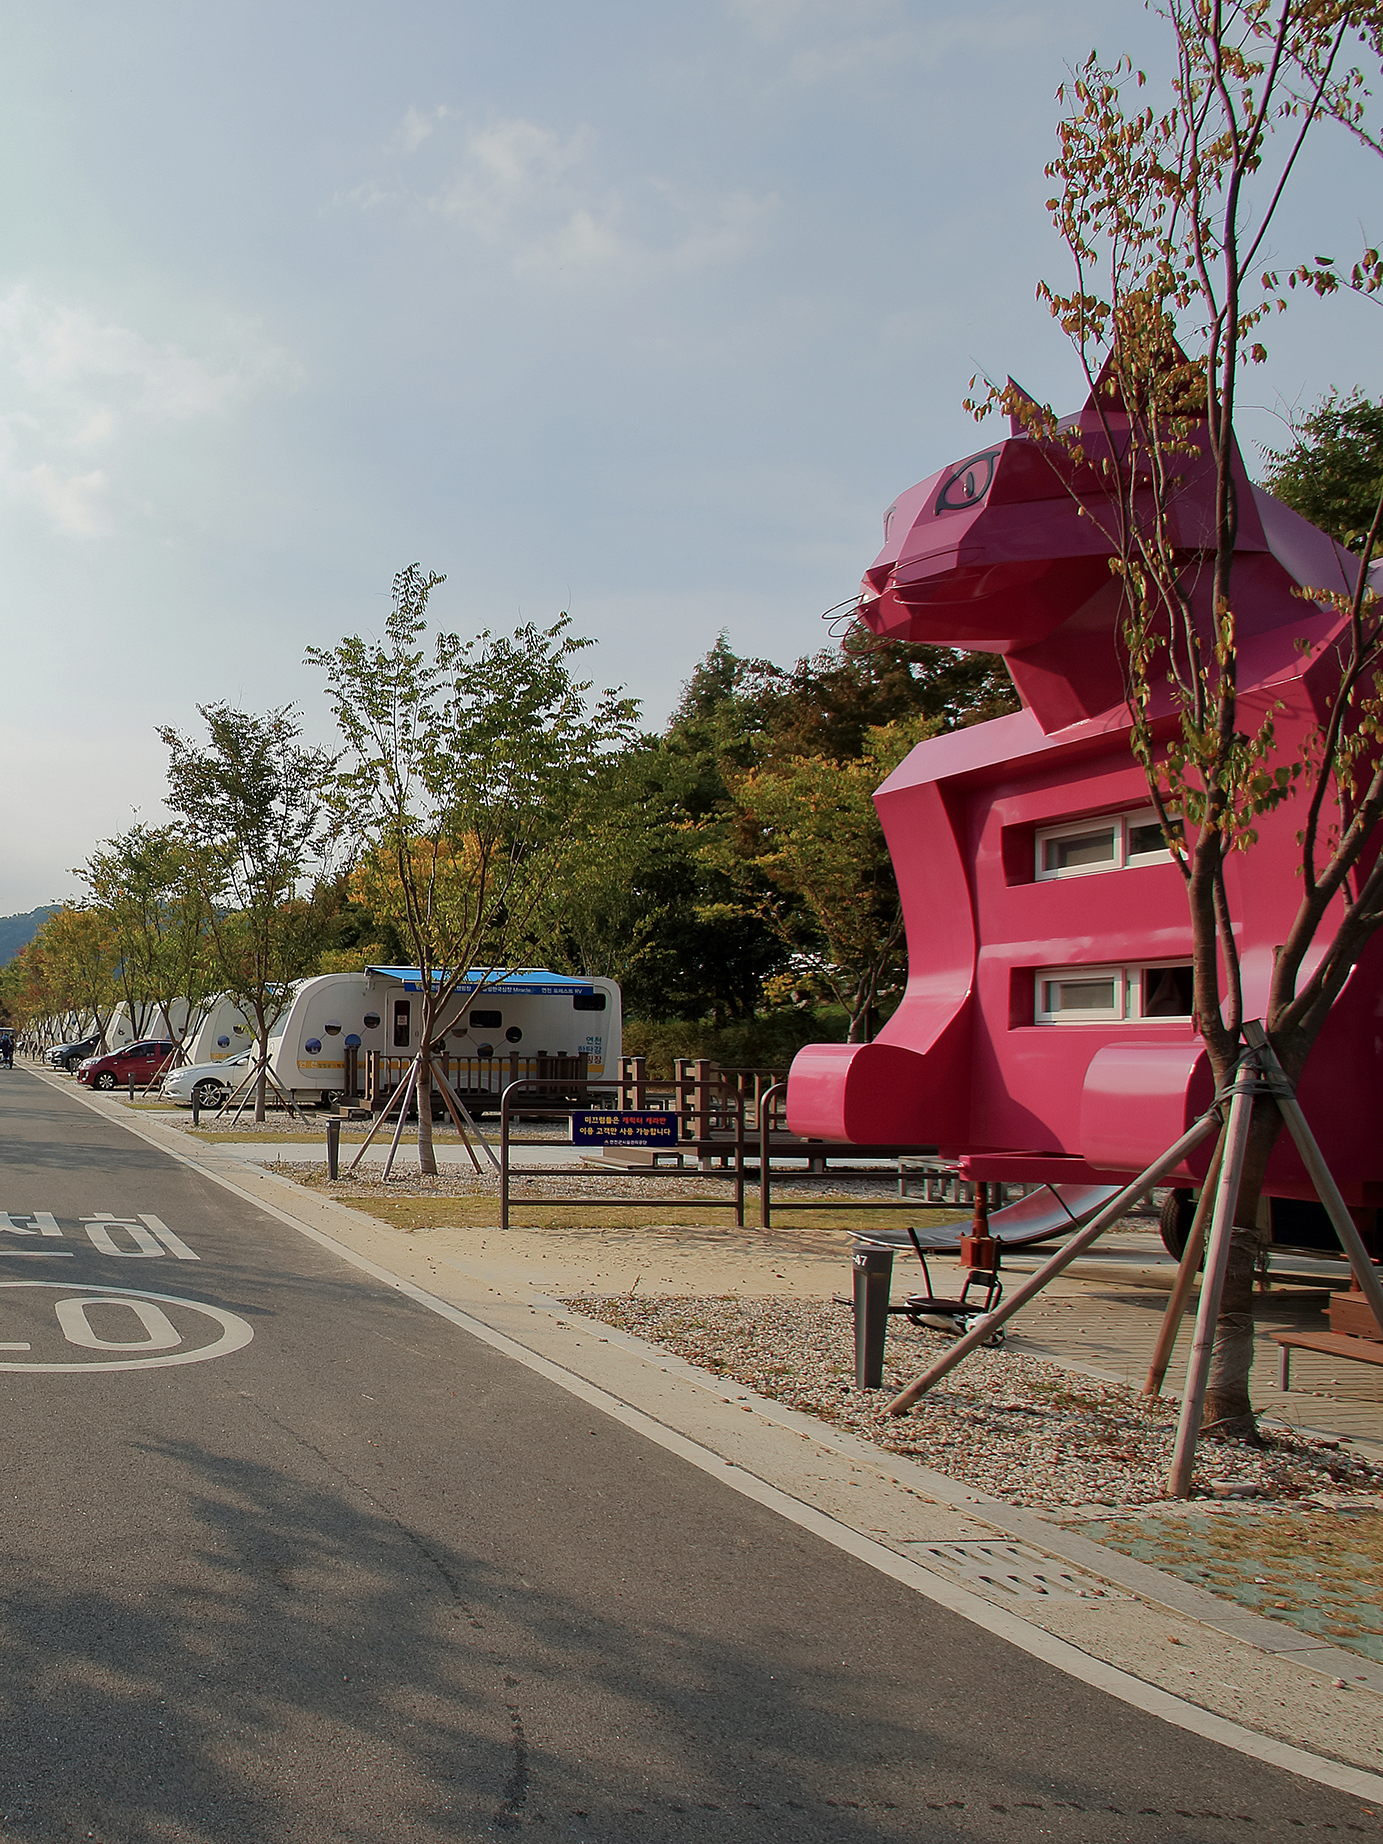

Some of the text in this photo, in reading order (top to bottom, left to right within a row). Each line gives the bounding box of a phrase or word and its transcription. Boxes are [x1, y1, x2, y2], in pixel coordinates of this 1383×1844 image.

[586, 1036, 602, 1045] 연천
[579, 1127, 671, 1136] 이용 고객만 사용 가능합니다
